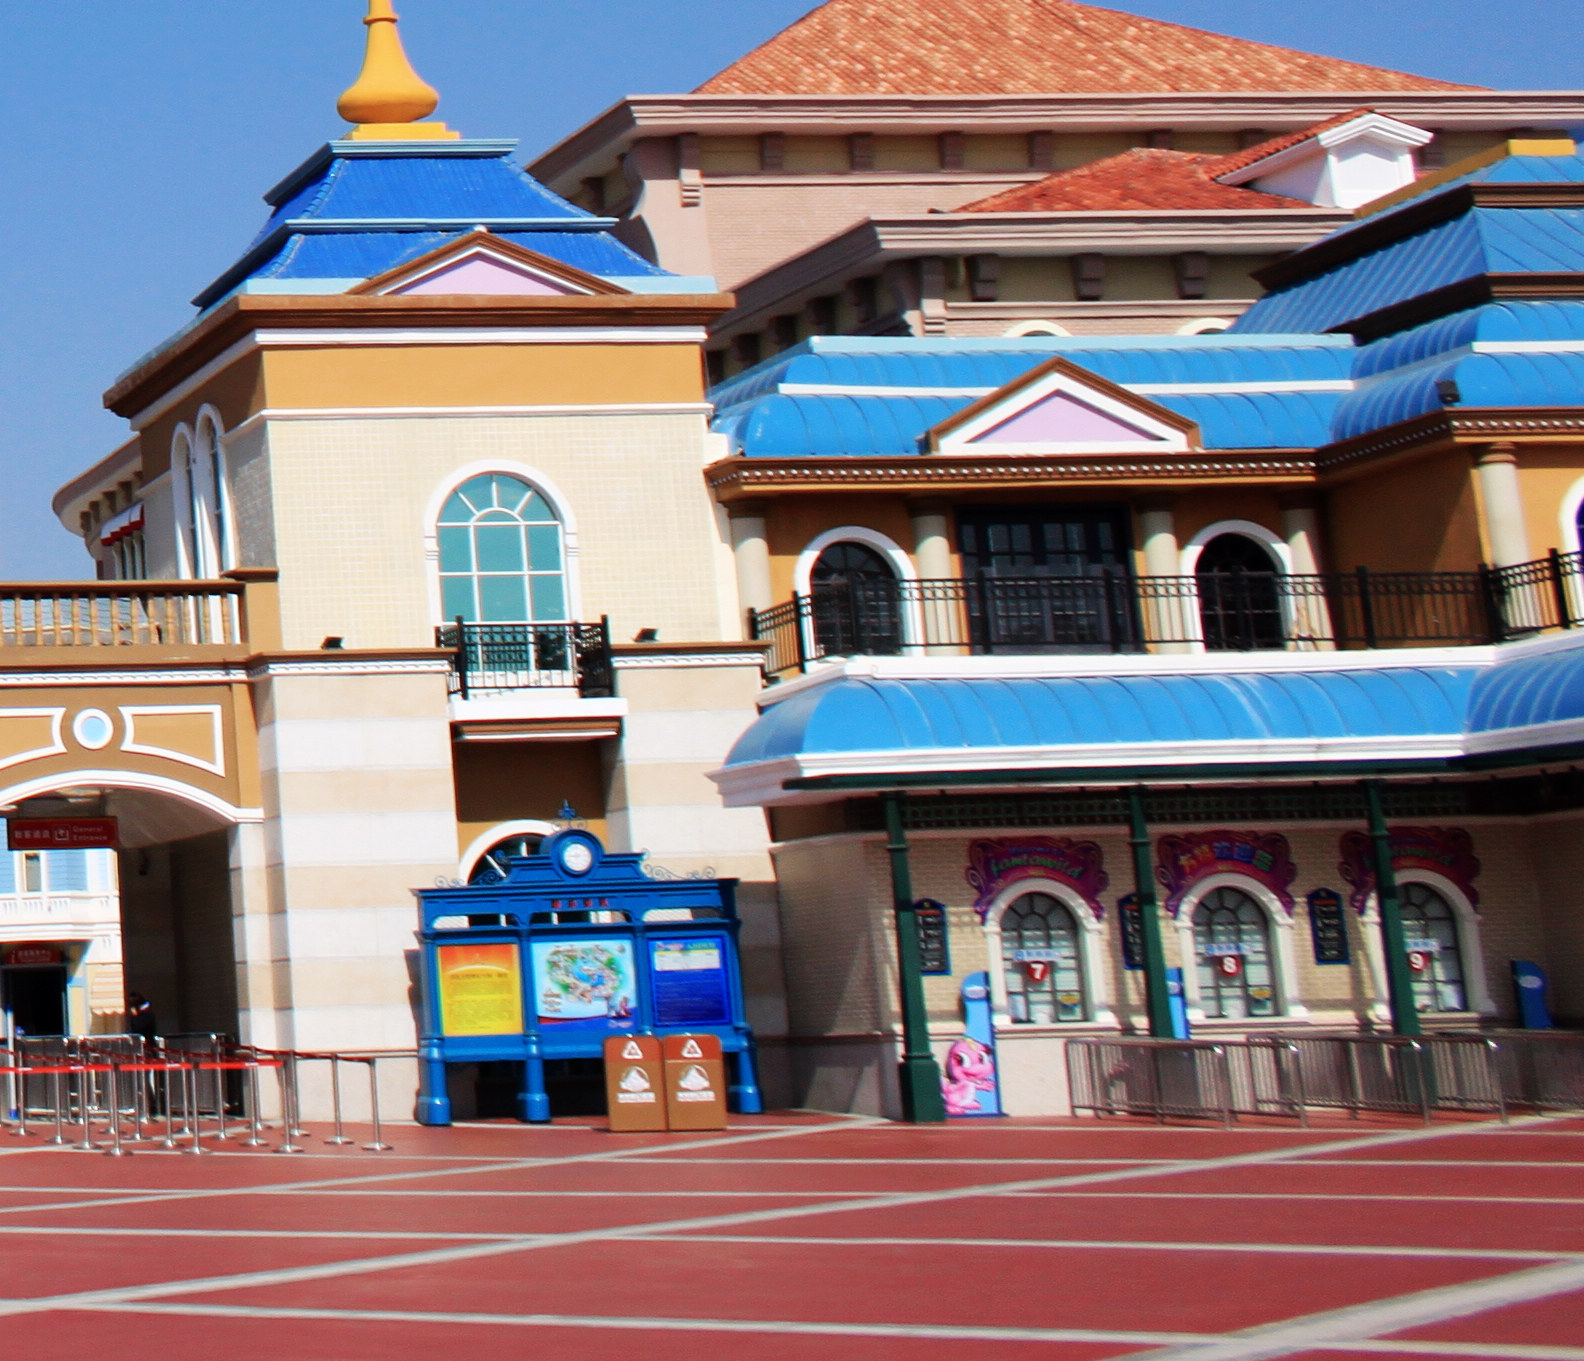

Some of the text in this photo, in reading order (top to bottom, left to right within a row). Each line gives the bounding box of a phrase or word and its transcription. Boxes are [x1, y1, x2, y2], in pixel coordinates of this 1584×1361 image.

[1223, 956, 1237, 973] 8
[1410, 953, 1424, 970] 9
[1030, 963, 1044, 980] 7
